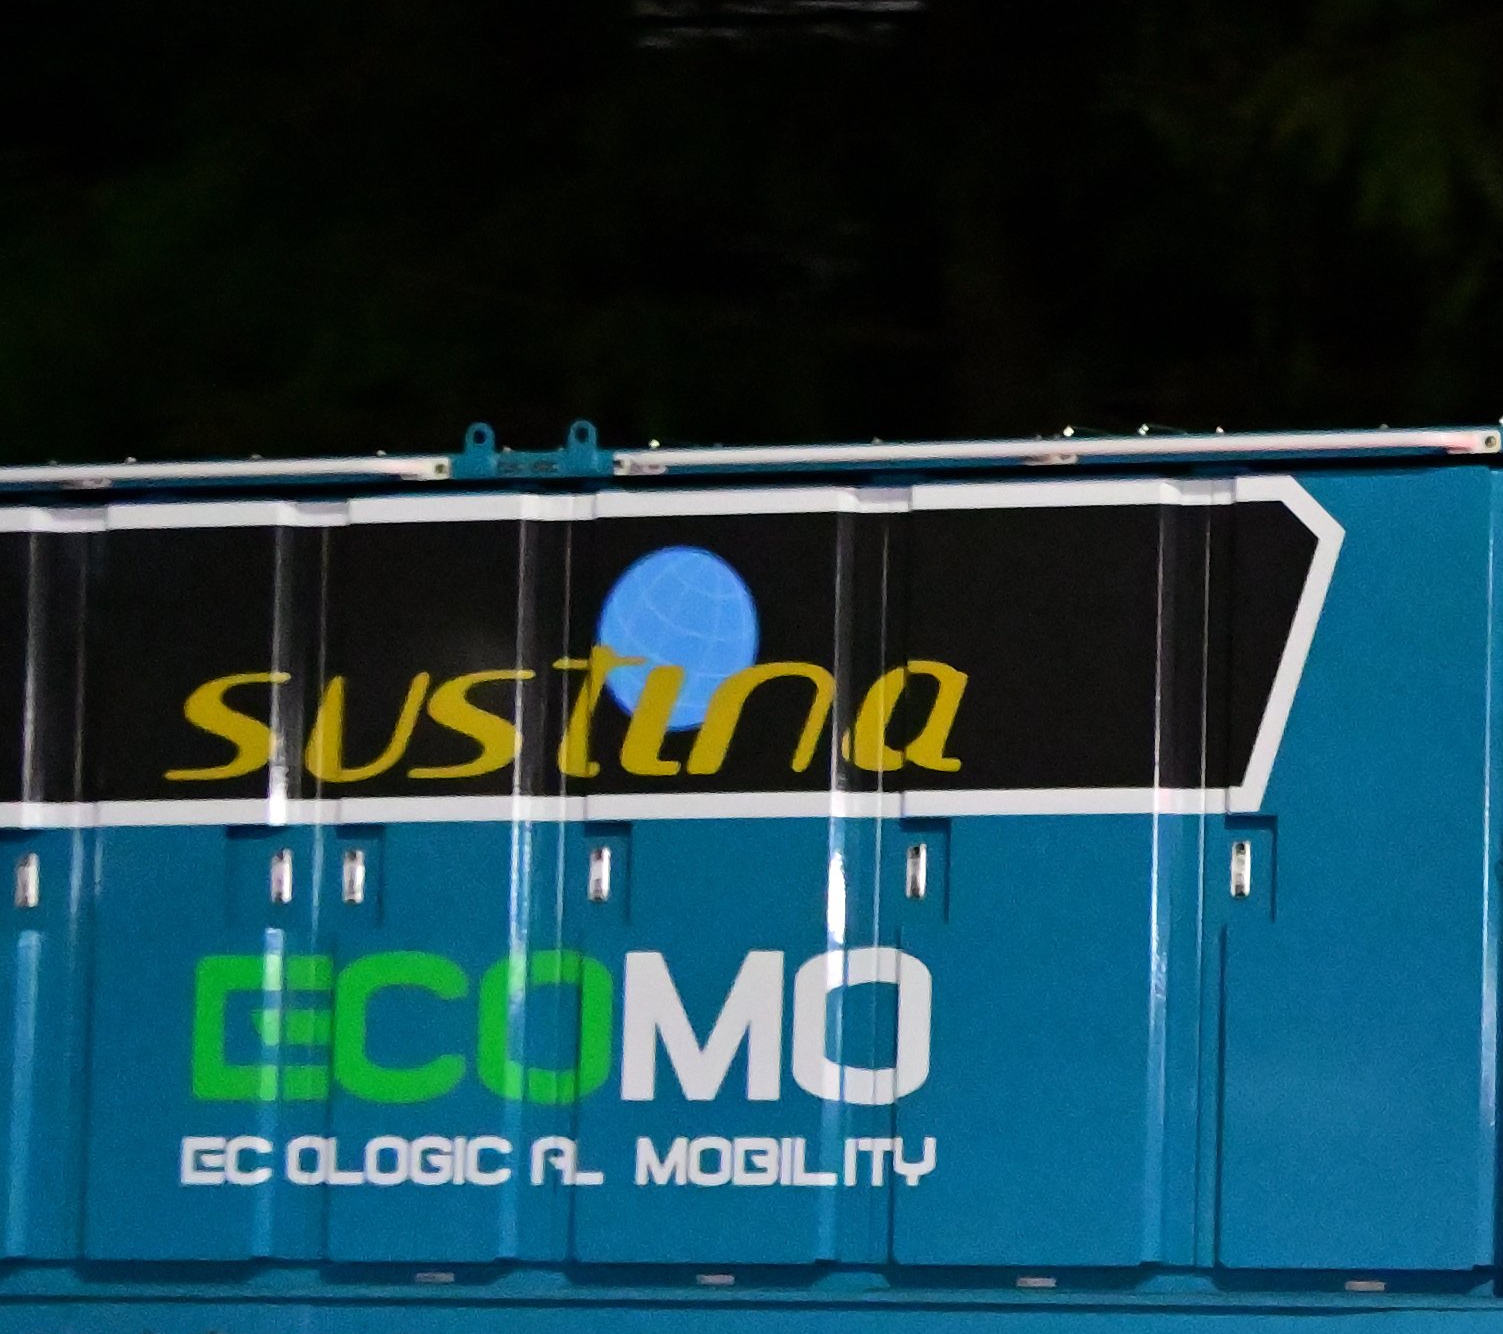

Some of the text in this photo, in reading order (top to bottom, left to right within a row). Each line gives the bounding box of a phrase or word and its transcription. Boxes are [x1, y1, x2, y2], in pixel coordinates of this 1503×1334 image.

[163, 646, 970, 784] sustina
[190, 945, 934, 1107] ECOMO
[180, 1135, 938, 1187] ECOLOGICAL MOBILITY
